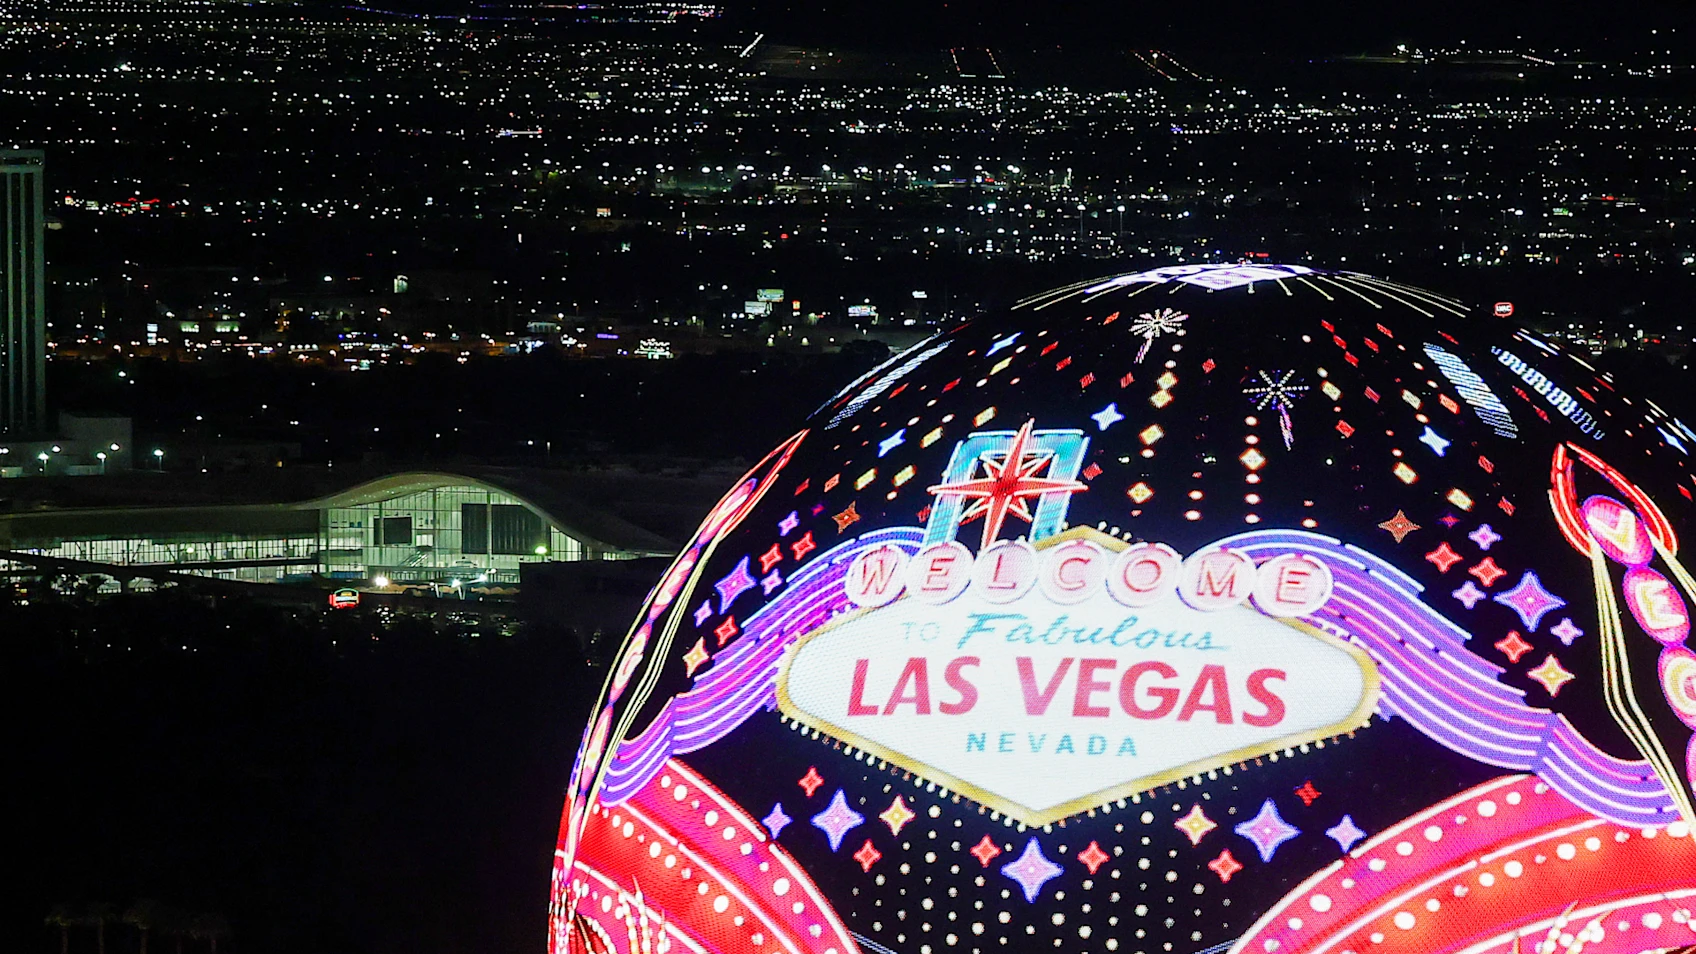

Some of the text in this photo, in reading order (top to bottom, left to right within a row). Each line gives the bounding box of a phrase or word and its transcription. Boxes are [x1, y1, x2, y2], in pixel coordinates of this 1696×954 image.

[855, 546, 1315, 606] WELCOME
[901, 612, 1231, 650] TO Fabulous
[846, 655, 1288, 728] LAS VEGAS
[965, 731, 1139, 758] NEVADA
